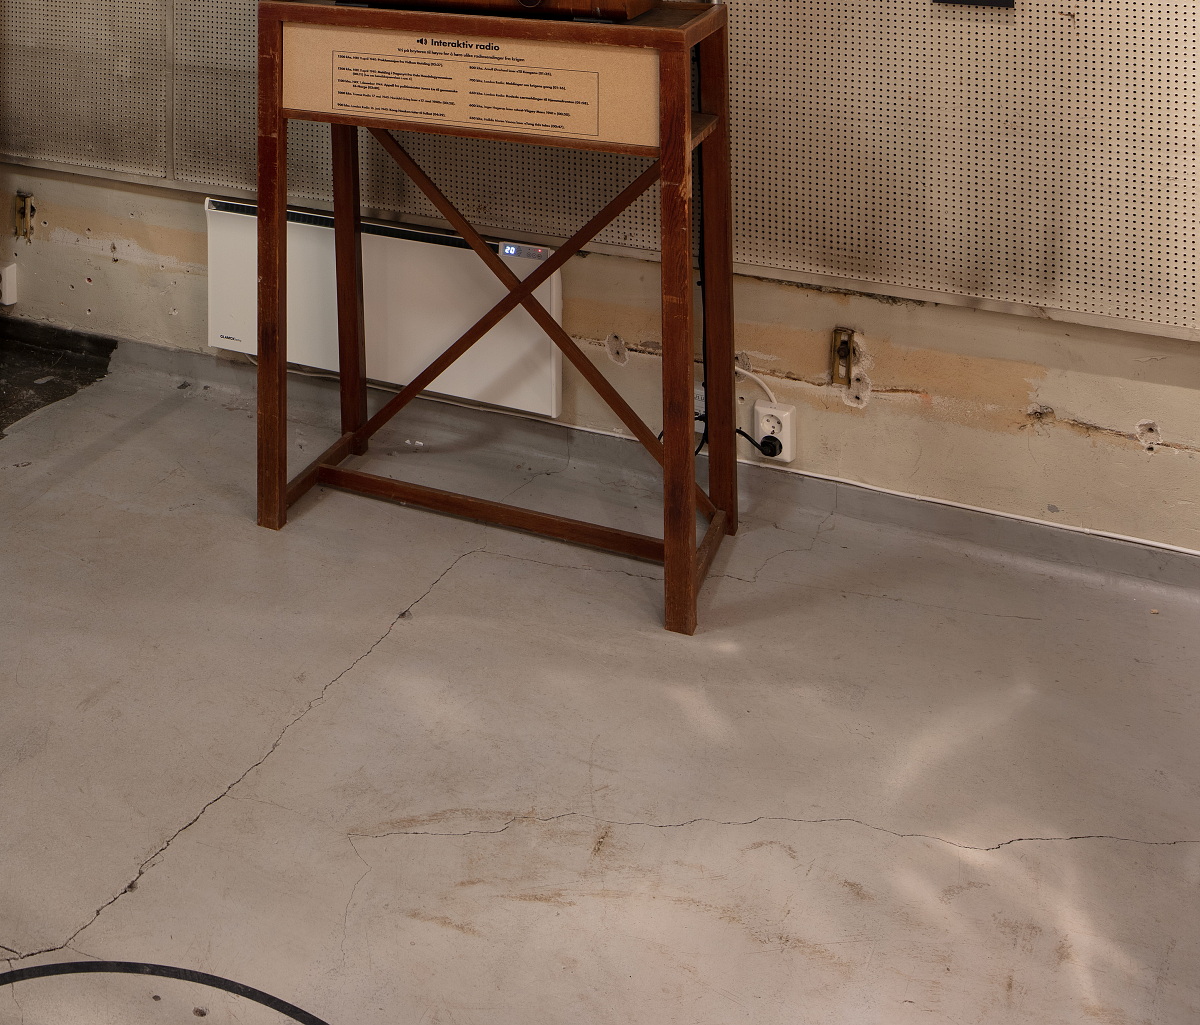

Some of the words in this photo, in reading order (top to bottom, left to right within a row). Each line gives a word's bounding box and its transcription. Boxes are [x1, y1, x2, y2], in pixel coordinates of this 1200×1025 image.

[431, 38, 473, 49] Interaktiv
[475, 43, 500, 51] radio
[505, 246, 516, 254] 20
